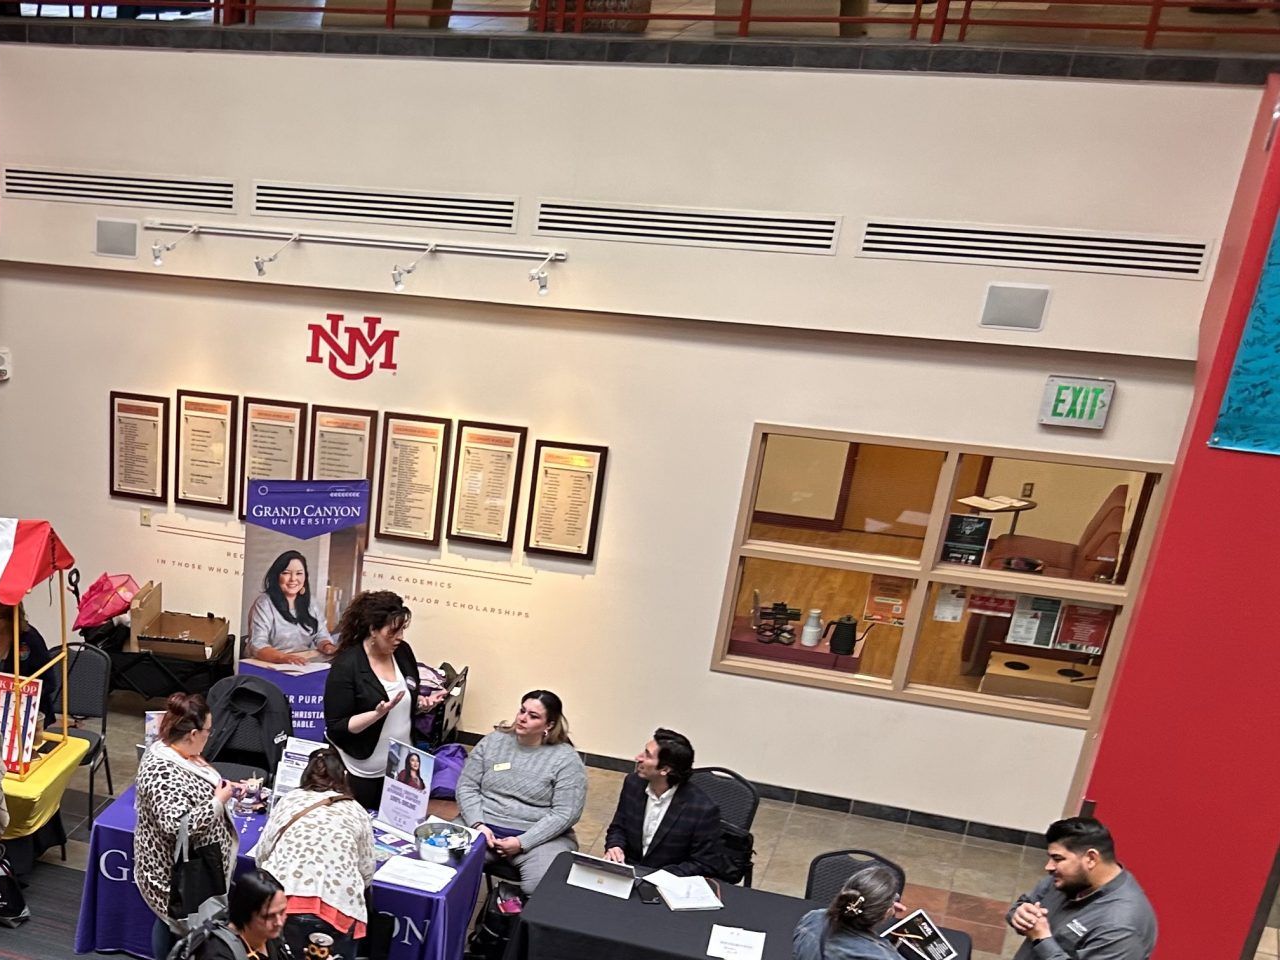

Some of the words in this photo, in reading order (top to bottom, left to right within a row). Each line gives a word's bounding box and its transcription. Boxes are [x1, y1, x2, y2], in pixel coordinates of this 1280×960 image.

[1051, 385, 1105, 420] EXIT
[252, 505, 301, 517] GRAND
[303, 505, 361, 517] CANYON
[390, 575, 453, 589] ACADEMICS
[171, 560, 202, 570] THOSE
[208, 566, 229, 574] WHO
[404, 594, 440, 605] MAJOR
[446, 600, 530, 619] SCHOLARSHIPS
[10, 681, 37, 694] DOP
[298, 695, 324, 704] PURP
[291, 711, 325, 719] CHRISTIA
